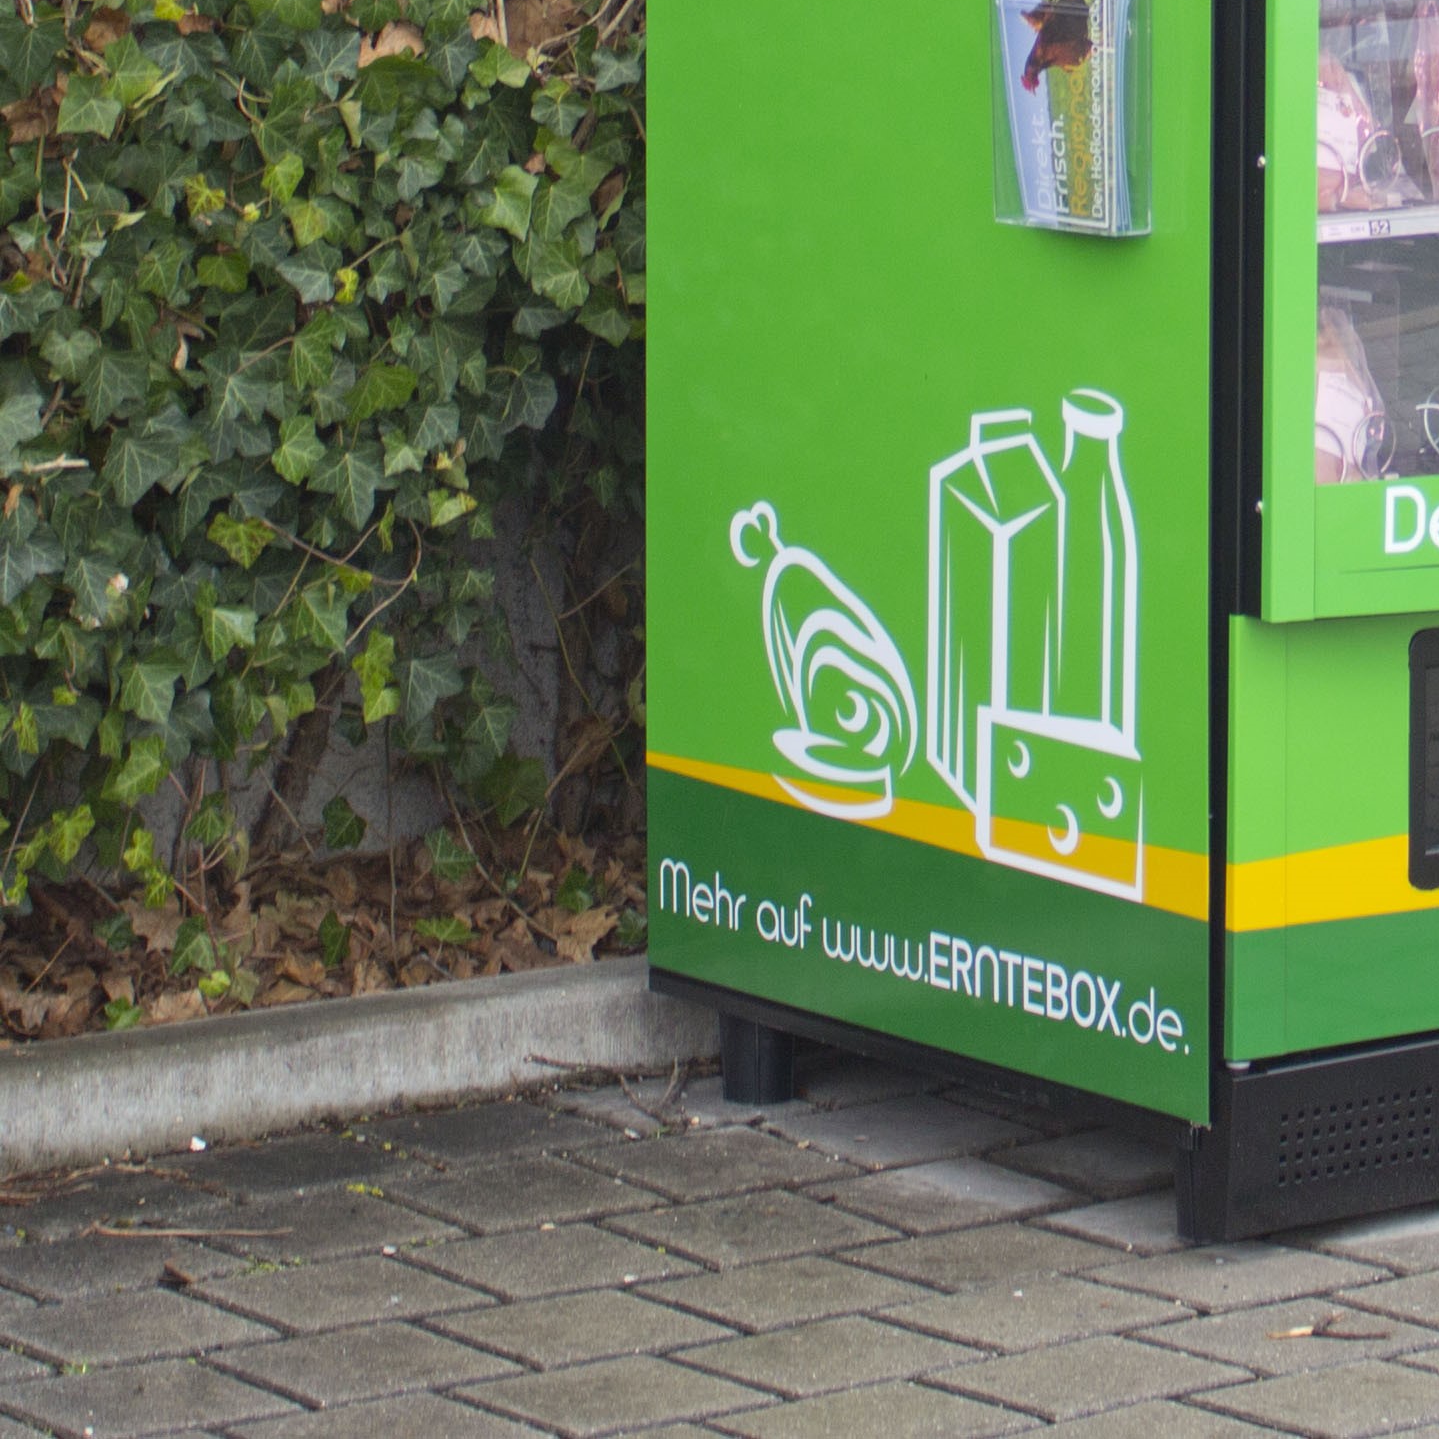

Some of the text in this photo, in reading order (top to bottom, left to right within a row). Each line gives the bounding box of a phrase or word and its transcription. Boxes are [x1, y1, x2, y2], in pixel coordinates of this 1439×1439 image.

[1031, 105, 1054, 211] Direkt.
[1049, 113, 1070, 213] Frisch.
[1092, 180, 1103, 218] Der
[1371, 220, 1390, 236] 52
[659, 857, 747, 932] Mehr
[756, 893, 813, 949] auf
